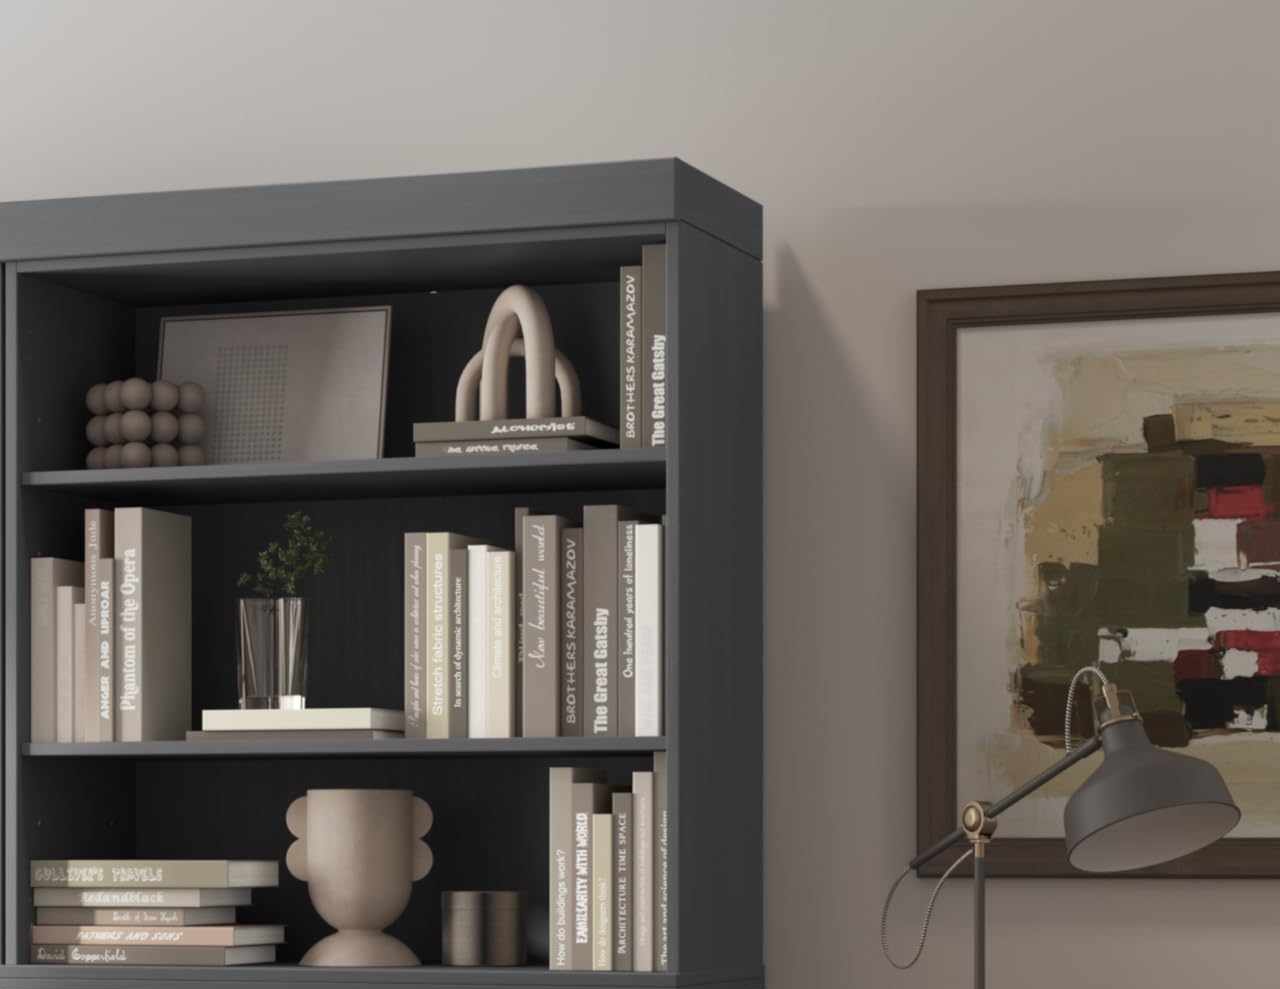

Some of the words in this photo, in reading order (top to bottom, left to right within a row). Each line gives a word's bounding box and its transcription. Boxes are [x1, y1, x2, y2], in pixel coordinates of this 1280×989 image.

[625, 273, 636, 364] KARAMAZOV
[651, 334, 666, 380] Gatsby
[625, 366, 636, 439] BROTHERS
[651, 381, 666, 420] Great
[651, 422, 666, 447] The
[530, 523, 545, 561] world
[622, 524, 633, 572] loneliness
[87, 555, 98, 627] Anonymous
[120, 547, 139, 596] Opera
[432, 552, 443, 622] structures
[566, 537, 577, 639] KARAMAZOV
[622, 573, 633, 585] of
[100, 580, 110, 635] UPROAR
[120, 599, 139, 624] the
[453, 576, 462, 625] architecture
[527, 568, 549, 630] beautiful
[624, 587, 634, 614] years
[120, 625, 139, 641] of
[432, 623, 443, 663] fabric
[453, 625, 464, 660] dynamic
[593, 607, 609, 659] Gatsby
[622, 617, 633, 655] hundred
[100, 640, 110, 670] AND
[622, 658, 633, 679] One
[100, 675, 110, 720] ANGER
[120, 645, 139, 711] Phantom
[432, 667, 443, 716] Stretch
[453, 671, 462, 698] search
[566, 642, 577, 724] BROTHERS
[593, 661, 609, 704] Great
[453, 698, 462, 708] In
[593, 705, 609, 734] The
[576, 812, 589, 848] WORLD
[618, 812, 626, 845] SPACE
[556, 848, 566, 880] work?
[576, 849, 589, 877] WITH
[618, 848, 626, 873] TIME
[555, 882, 568, 926] buildings
[576, 876, 589, 944] FAMILIARITY
[618, 876, 626, 954] ARCHITECTURE
[556, 927, 566, 941] do
[37, 948, 66, 960] David
[71, 948, 127, 964] Copperfield
[556, 943, 566, 967] How
